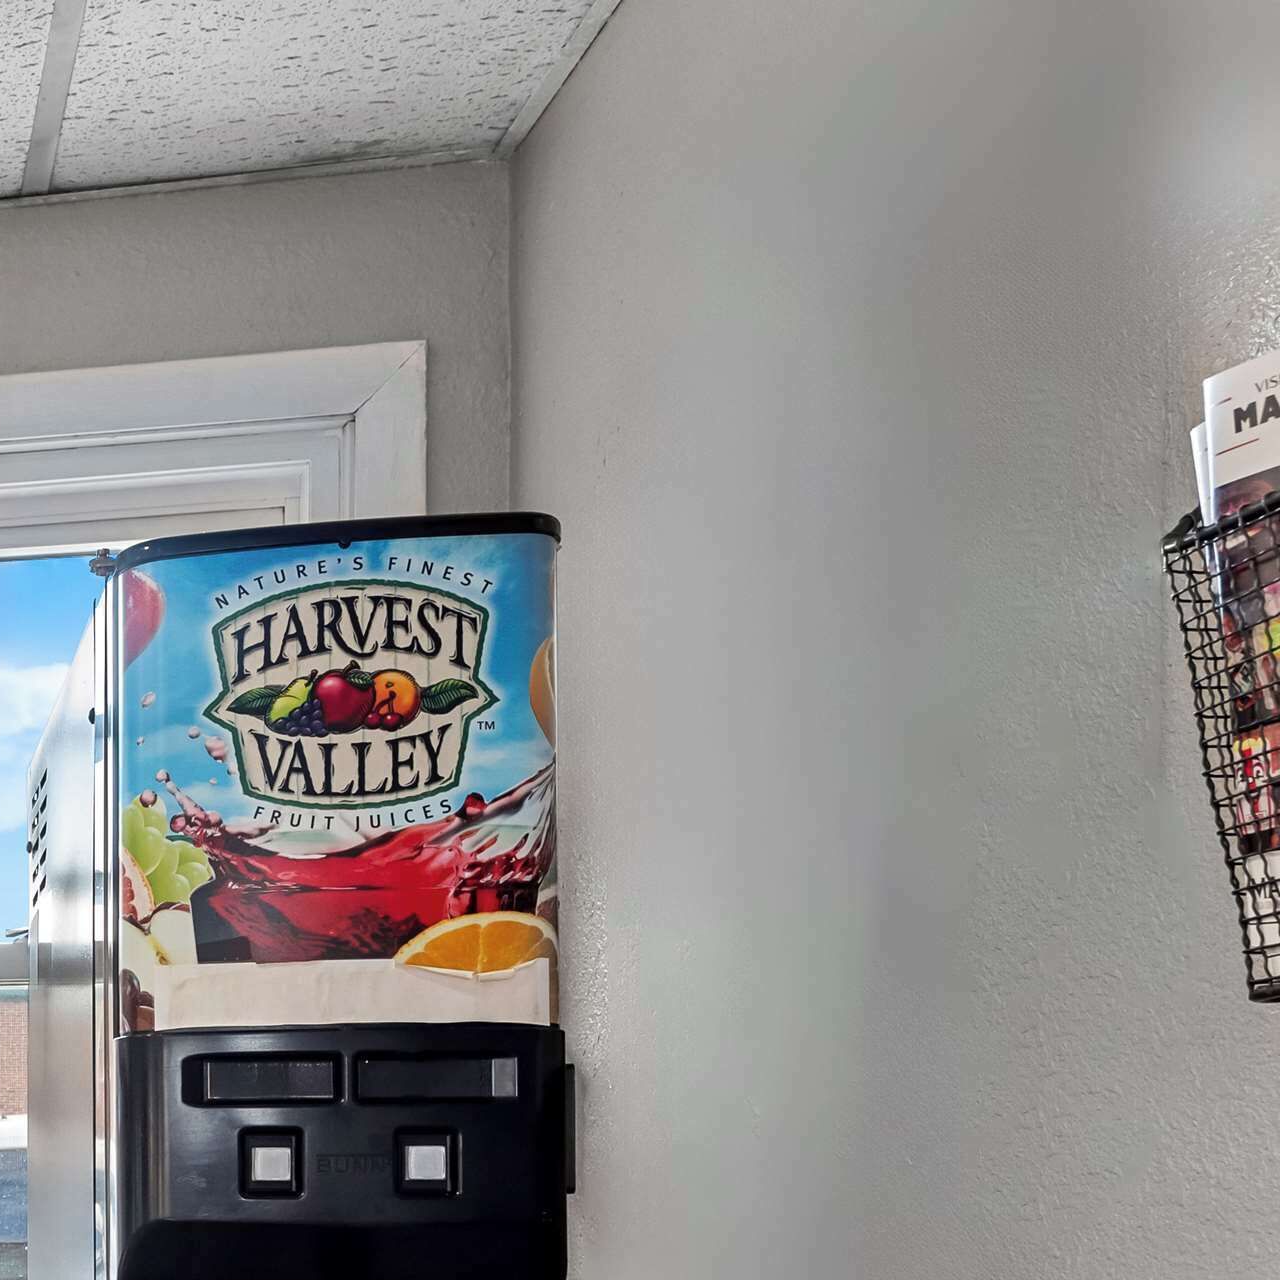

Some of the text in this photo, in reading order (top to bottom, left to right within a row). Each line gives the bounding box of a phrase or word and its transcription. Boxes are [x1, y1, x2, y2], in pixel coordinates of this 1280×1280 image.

[1254, 375, 1280, 393] VIS
[215, 555, 494, 610] NATURE'S FINEST
[230, 593, 480, 685] HARVEST
[248, 722, 453, 797] VALLEY
[253, 798, 453, 832] FRUIT JUICES
